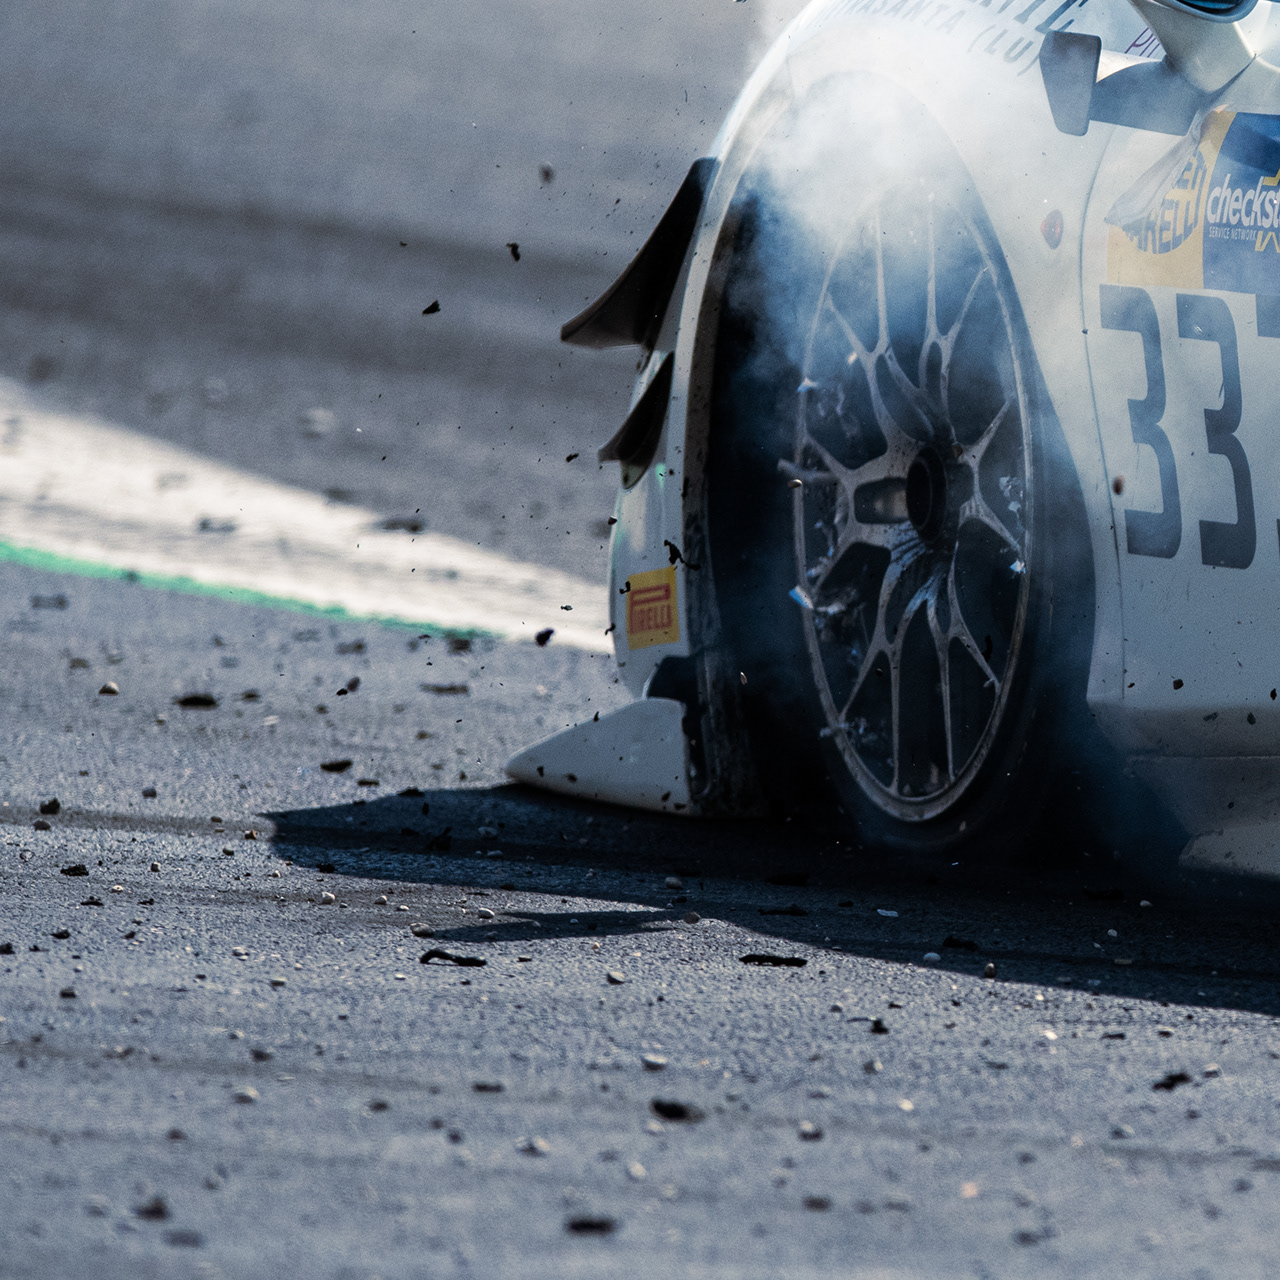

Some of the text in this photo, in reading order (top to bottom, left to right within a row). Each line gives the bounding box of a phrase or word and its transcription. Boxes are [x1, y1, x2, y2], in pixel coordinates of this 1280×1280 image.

[1208, 226, 1257, 242] SERVICE NETWORK
[628, 583, 672, 635] PIRELLI
